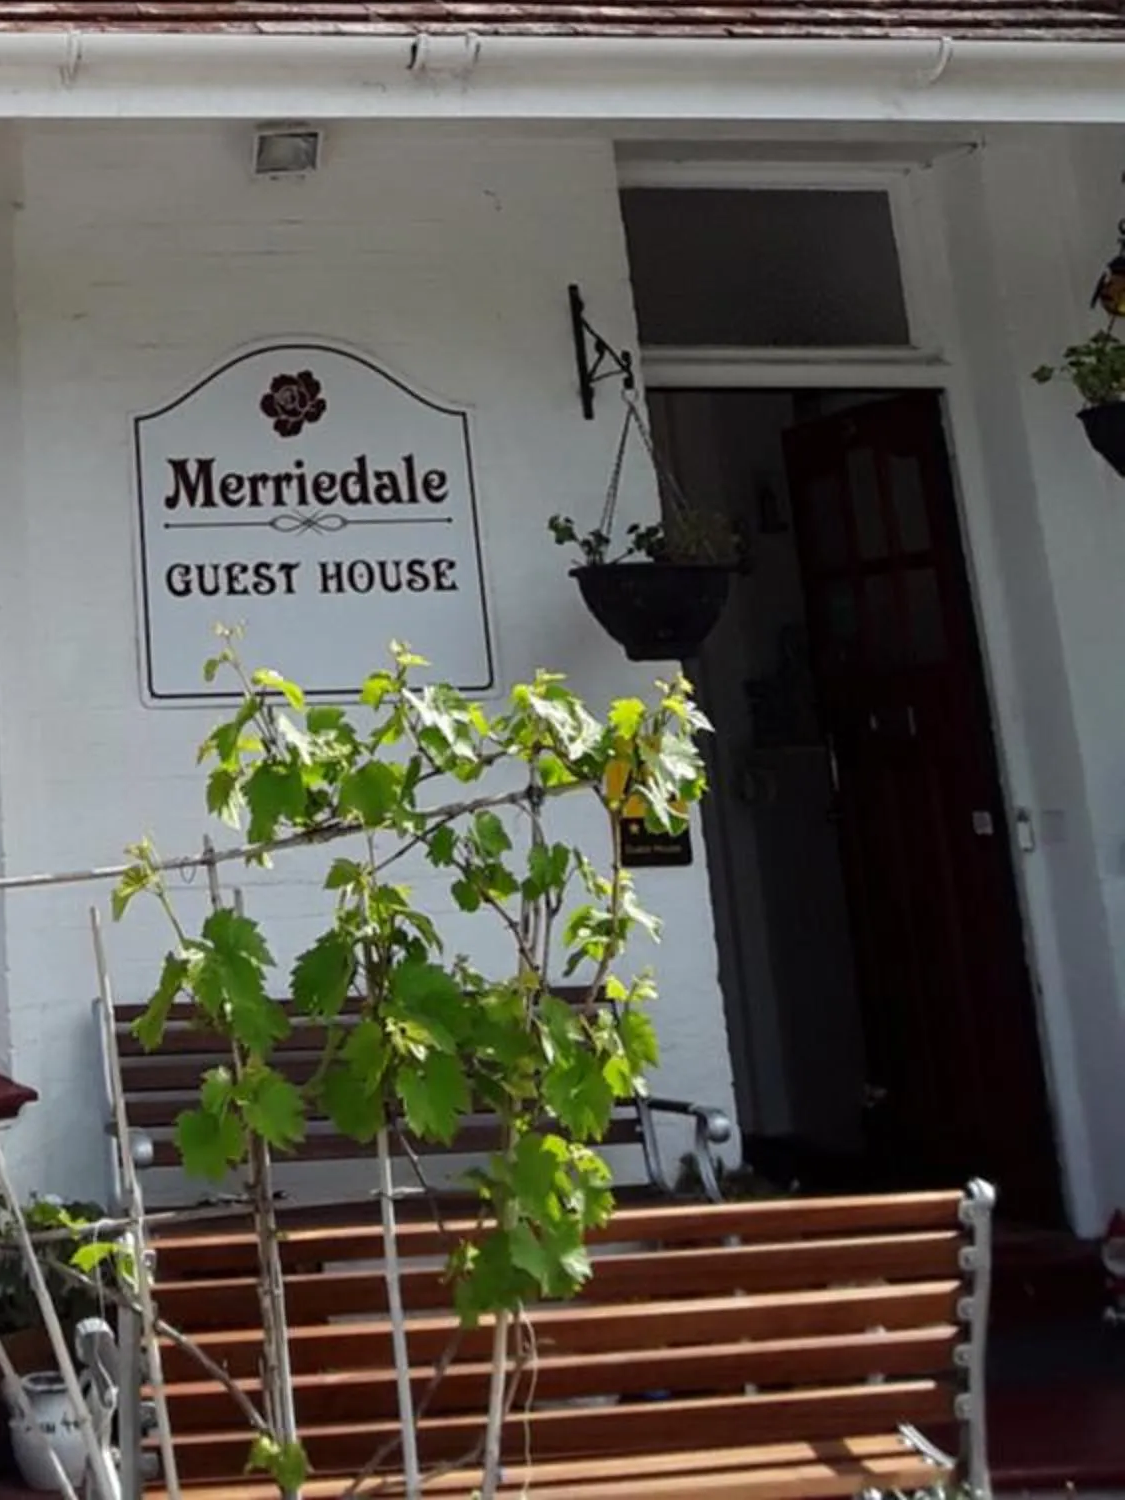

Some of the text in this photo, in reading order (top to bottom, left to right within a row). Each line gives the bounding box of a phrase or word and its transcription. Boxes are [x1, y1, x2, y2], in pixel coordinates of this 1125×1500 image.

[164, 453, 449, 510] Merriedale
[165, 558, 459, 597] GUEST HOUSE
